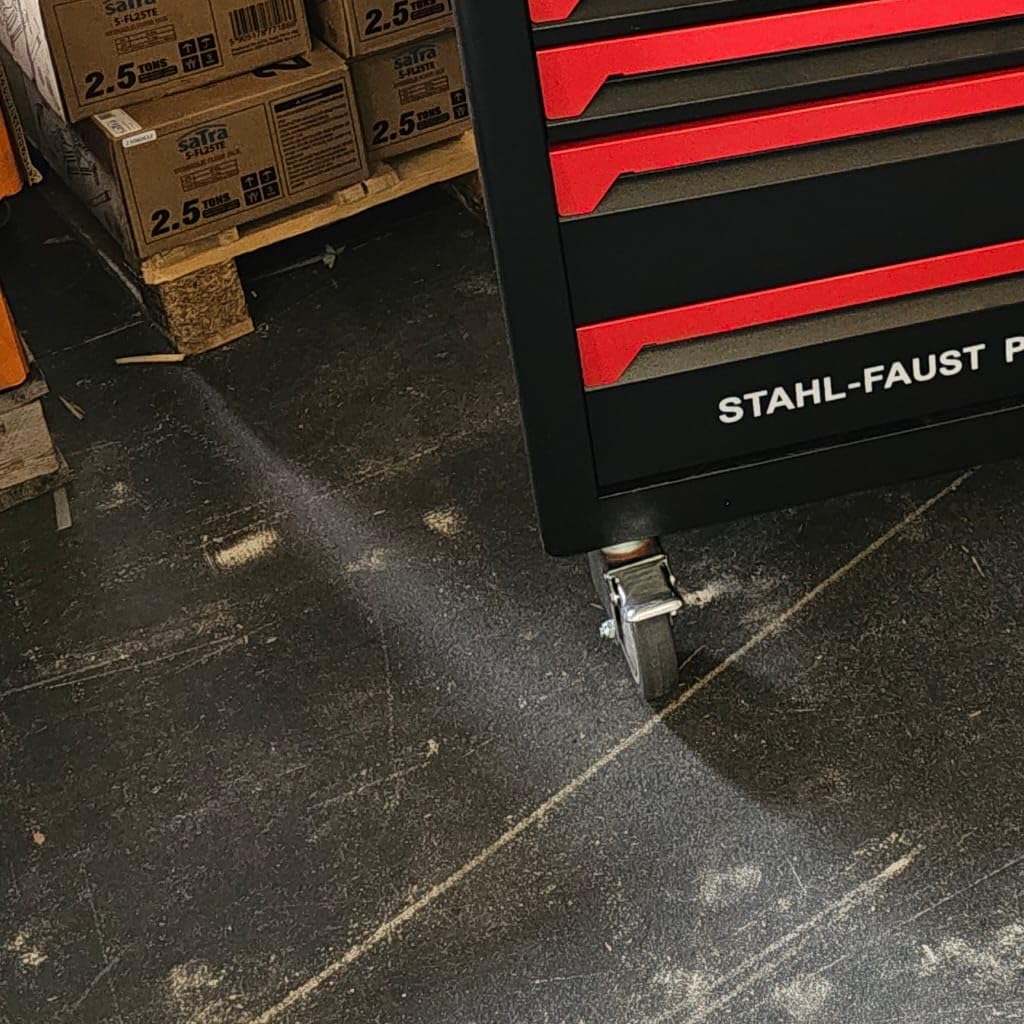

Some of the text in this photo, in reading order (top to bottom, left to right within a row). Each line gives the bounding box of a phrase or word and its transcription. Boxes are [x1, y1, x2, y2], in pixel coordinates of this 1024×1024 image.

[365, 0, 409, 35] 2.5
[85, 58, 169, 100] 2.5 TONS
[373, 111, 415, 145] 2.5
[151, 192, 231, 236] 2.5 TONS
[718, 343, 986, 424] STAHL-FAUST
